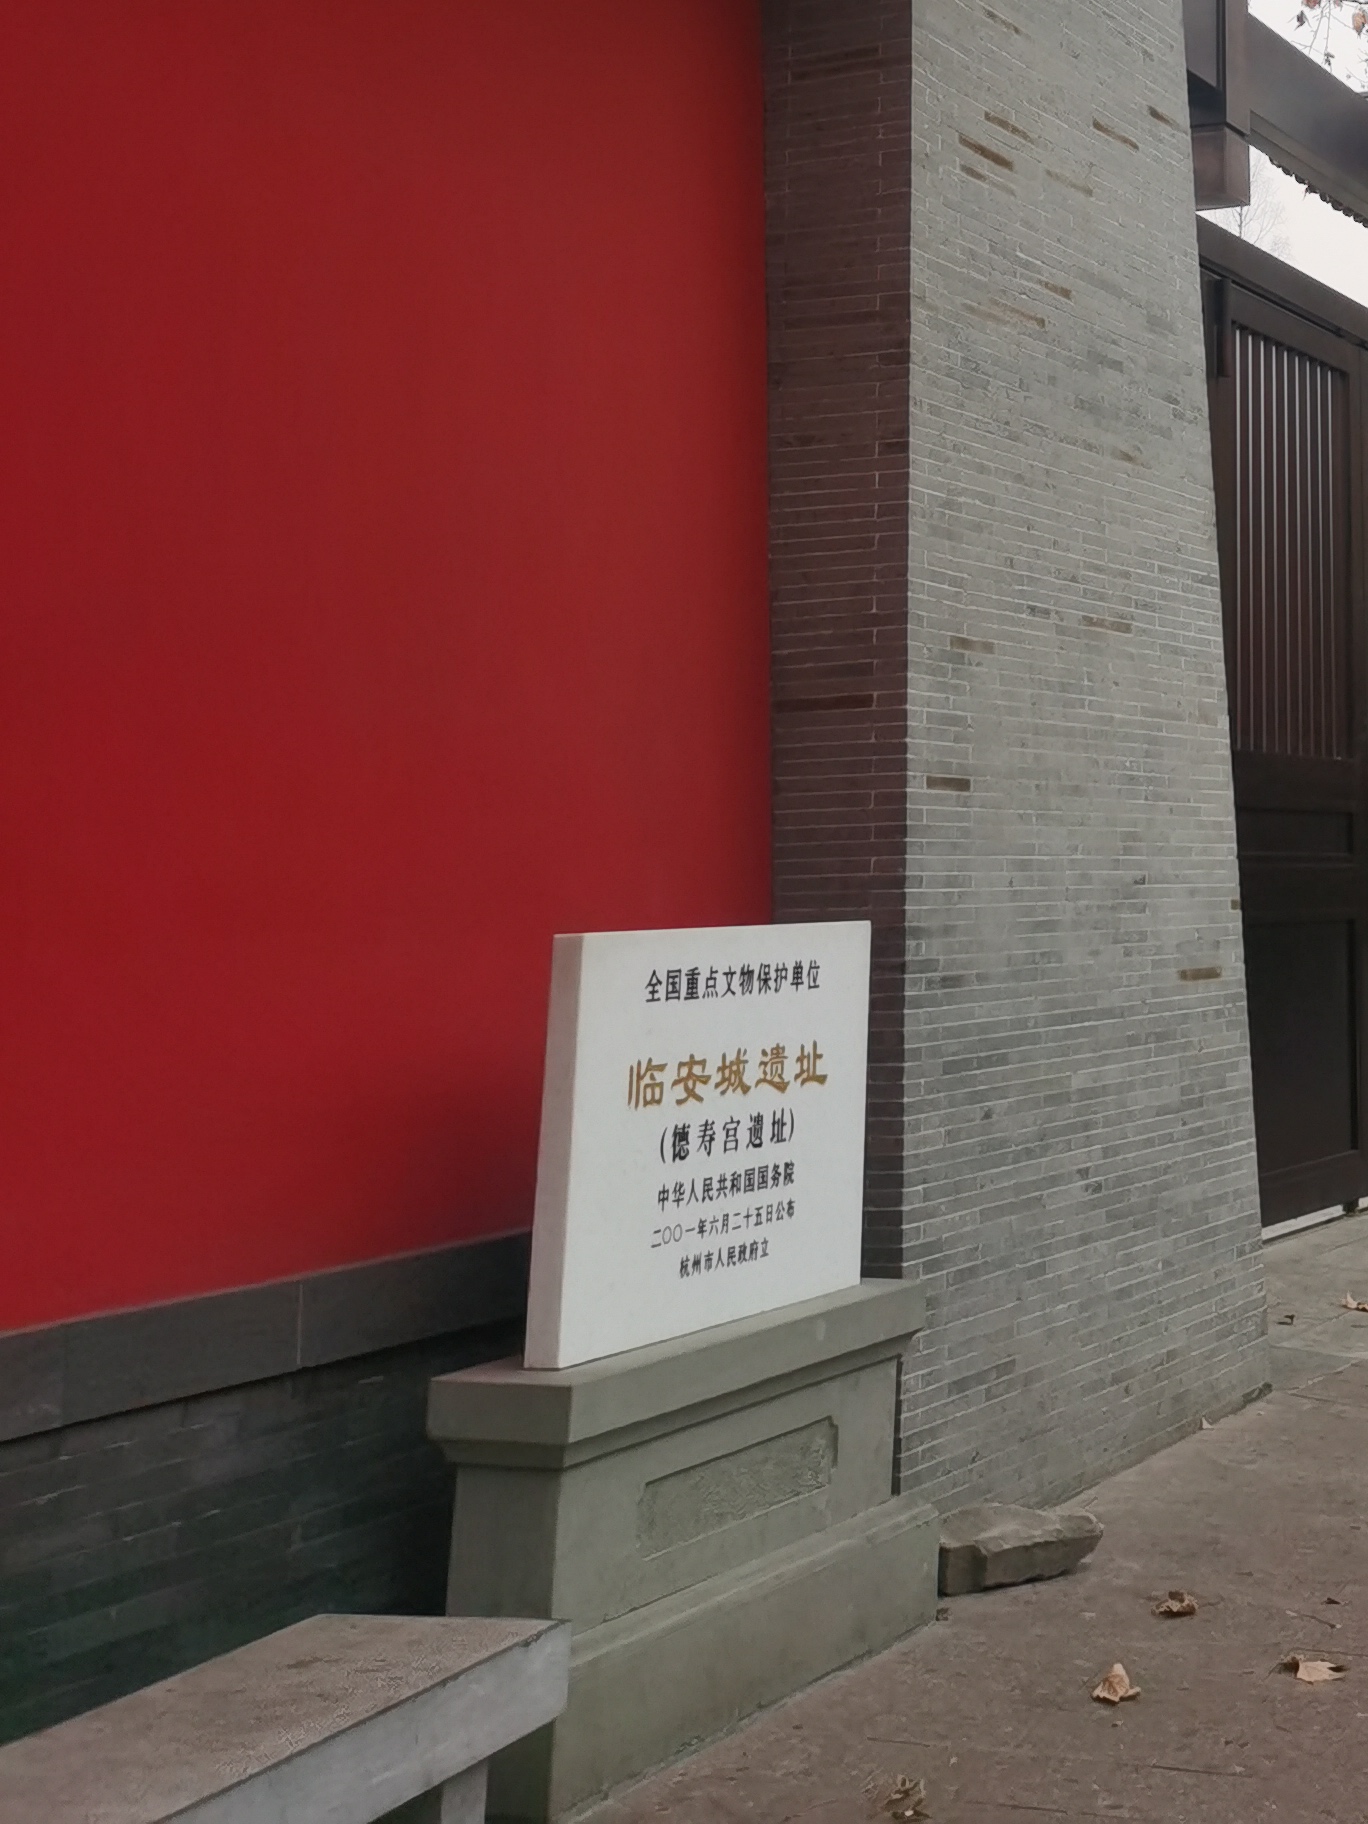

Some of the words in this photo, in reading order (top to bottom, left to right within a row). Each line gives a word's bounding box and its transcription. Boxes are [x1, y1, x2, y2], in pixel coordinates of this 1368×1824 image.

[645, 959, 820, 1003] 全国重点文物保护单位
[628, 1040, 828, 1110] 临安城遗址
[657, 1160, 795, 1212] 中华人民共和国国务院
[679, 1237, 770, 1279] 杭州市人民政府立
